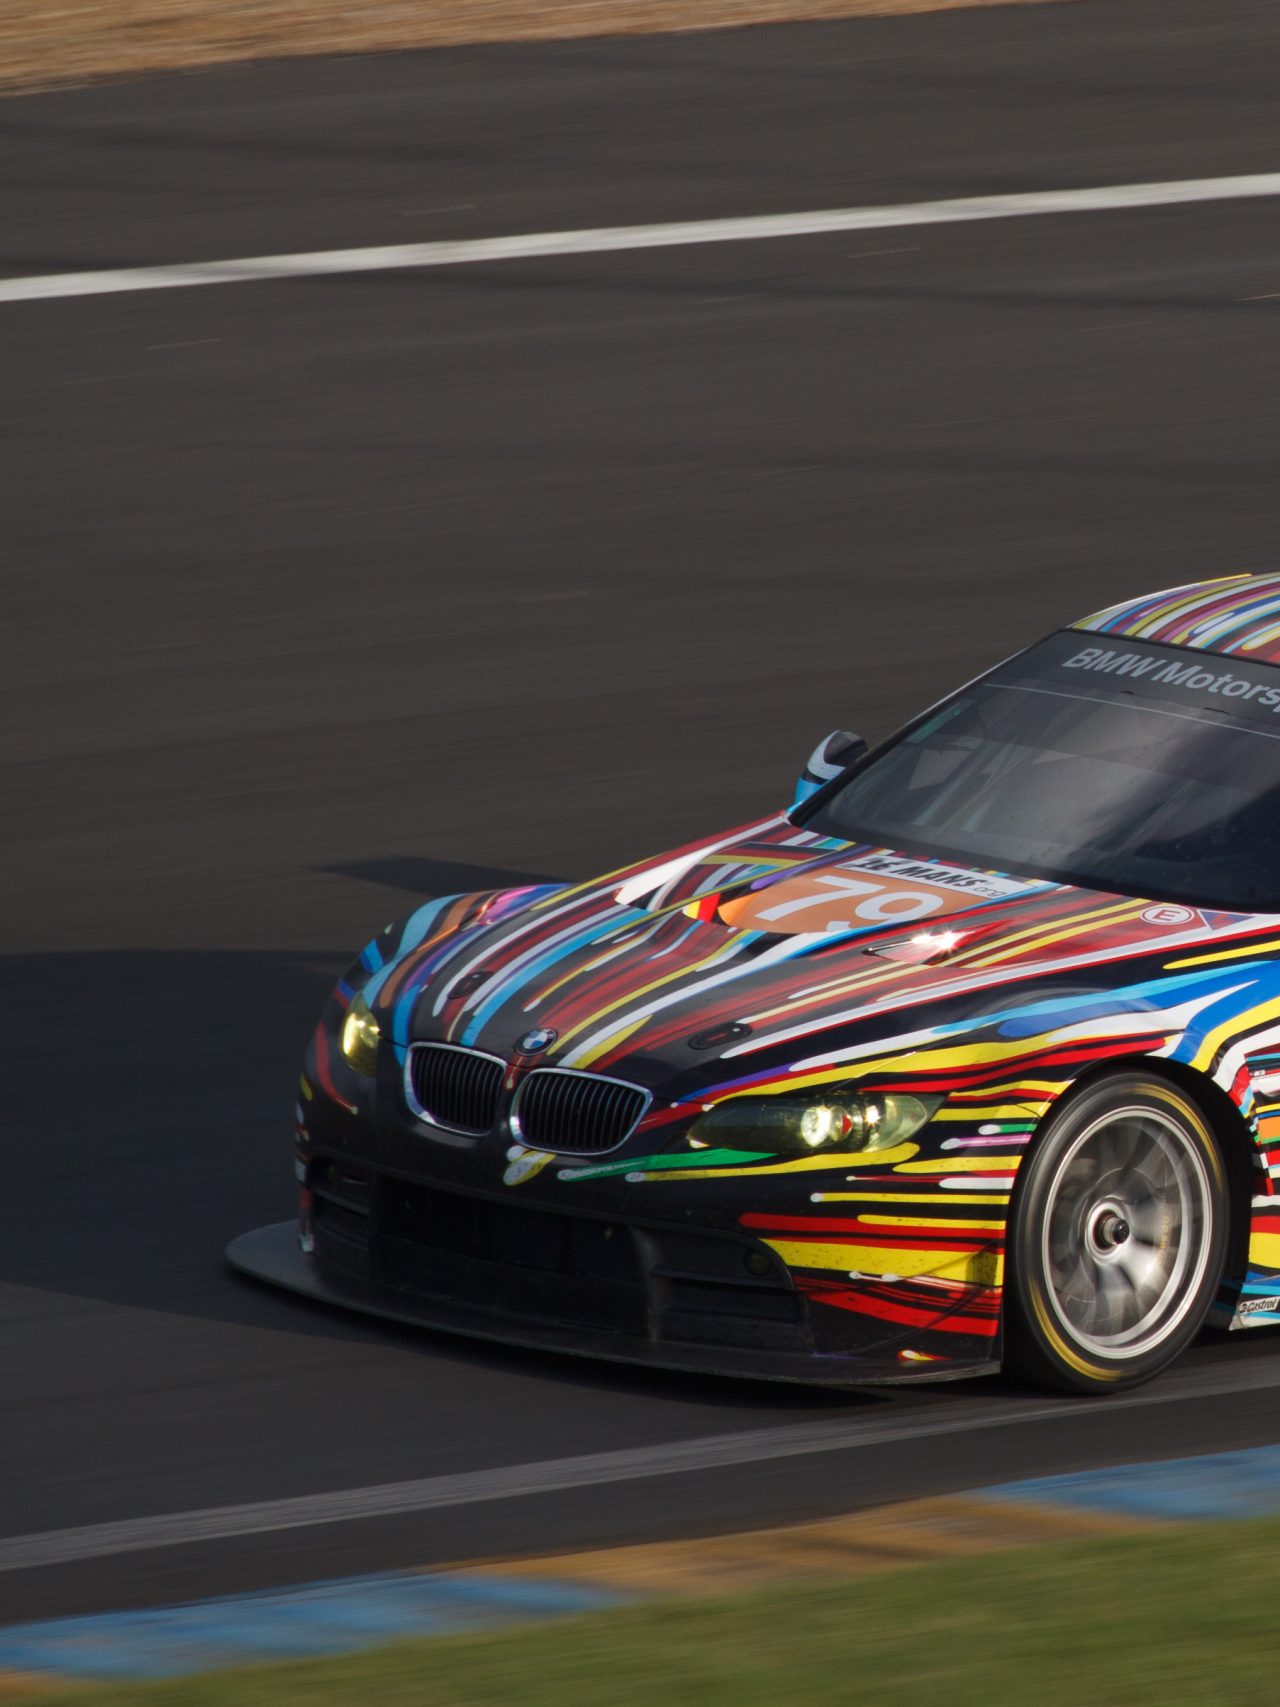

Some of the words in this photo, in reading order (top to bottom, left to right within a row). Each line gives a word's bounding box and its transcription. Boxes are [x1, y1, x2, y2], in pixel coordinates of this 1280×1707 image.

[1062, 647, 1162, 679] BMW
[890, 866, 987, 887] MANS
[754, 875, 945, 932] 79
[1152, 909, 1182, 922] E
[1247, 1298, 1277, 1313] Castrol
